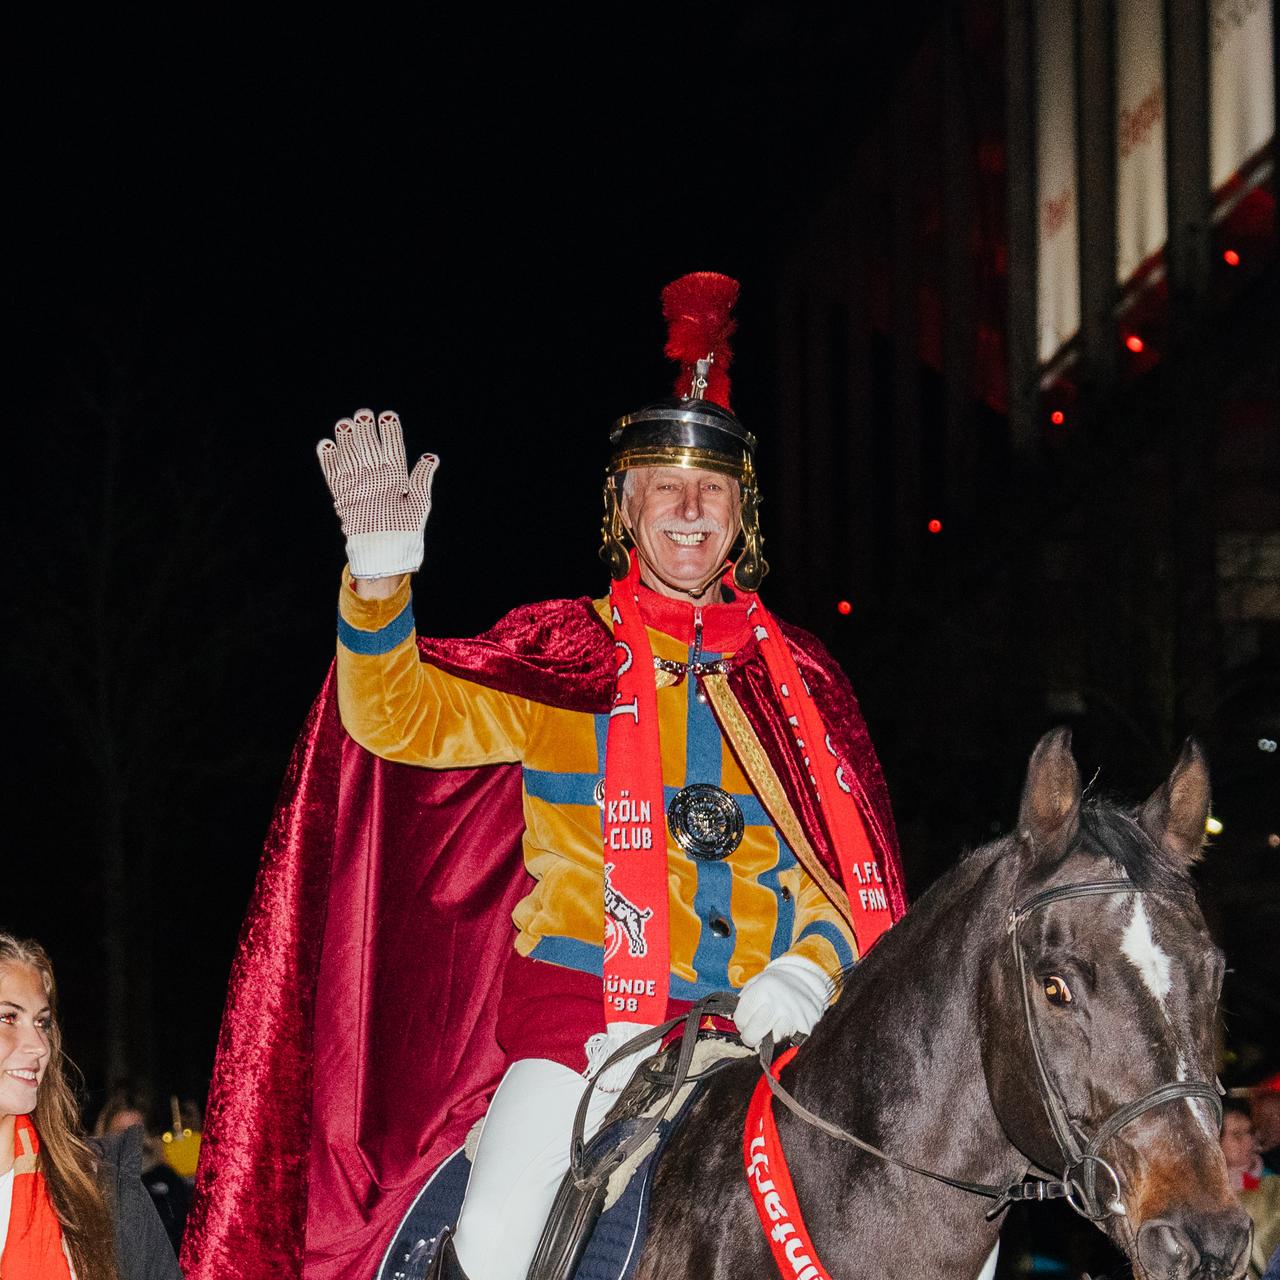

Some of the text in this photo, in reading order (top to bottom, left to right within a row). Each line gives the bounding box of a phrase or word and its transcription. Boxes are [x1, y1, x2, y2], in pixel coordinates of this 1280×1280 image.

[608, 790, 651, 823] KÖLN
[852, 861, 882, 884] 1.FC
[858, 888, 887, 910] FAN
[603, 975, 655, 996] ÜNDE
[608, 995, 638, 1012] '98
